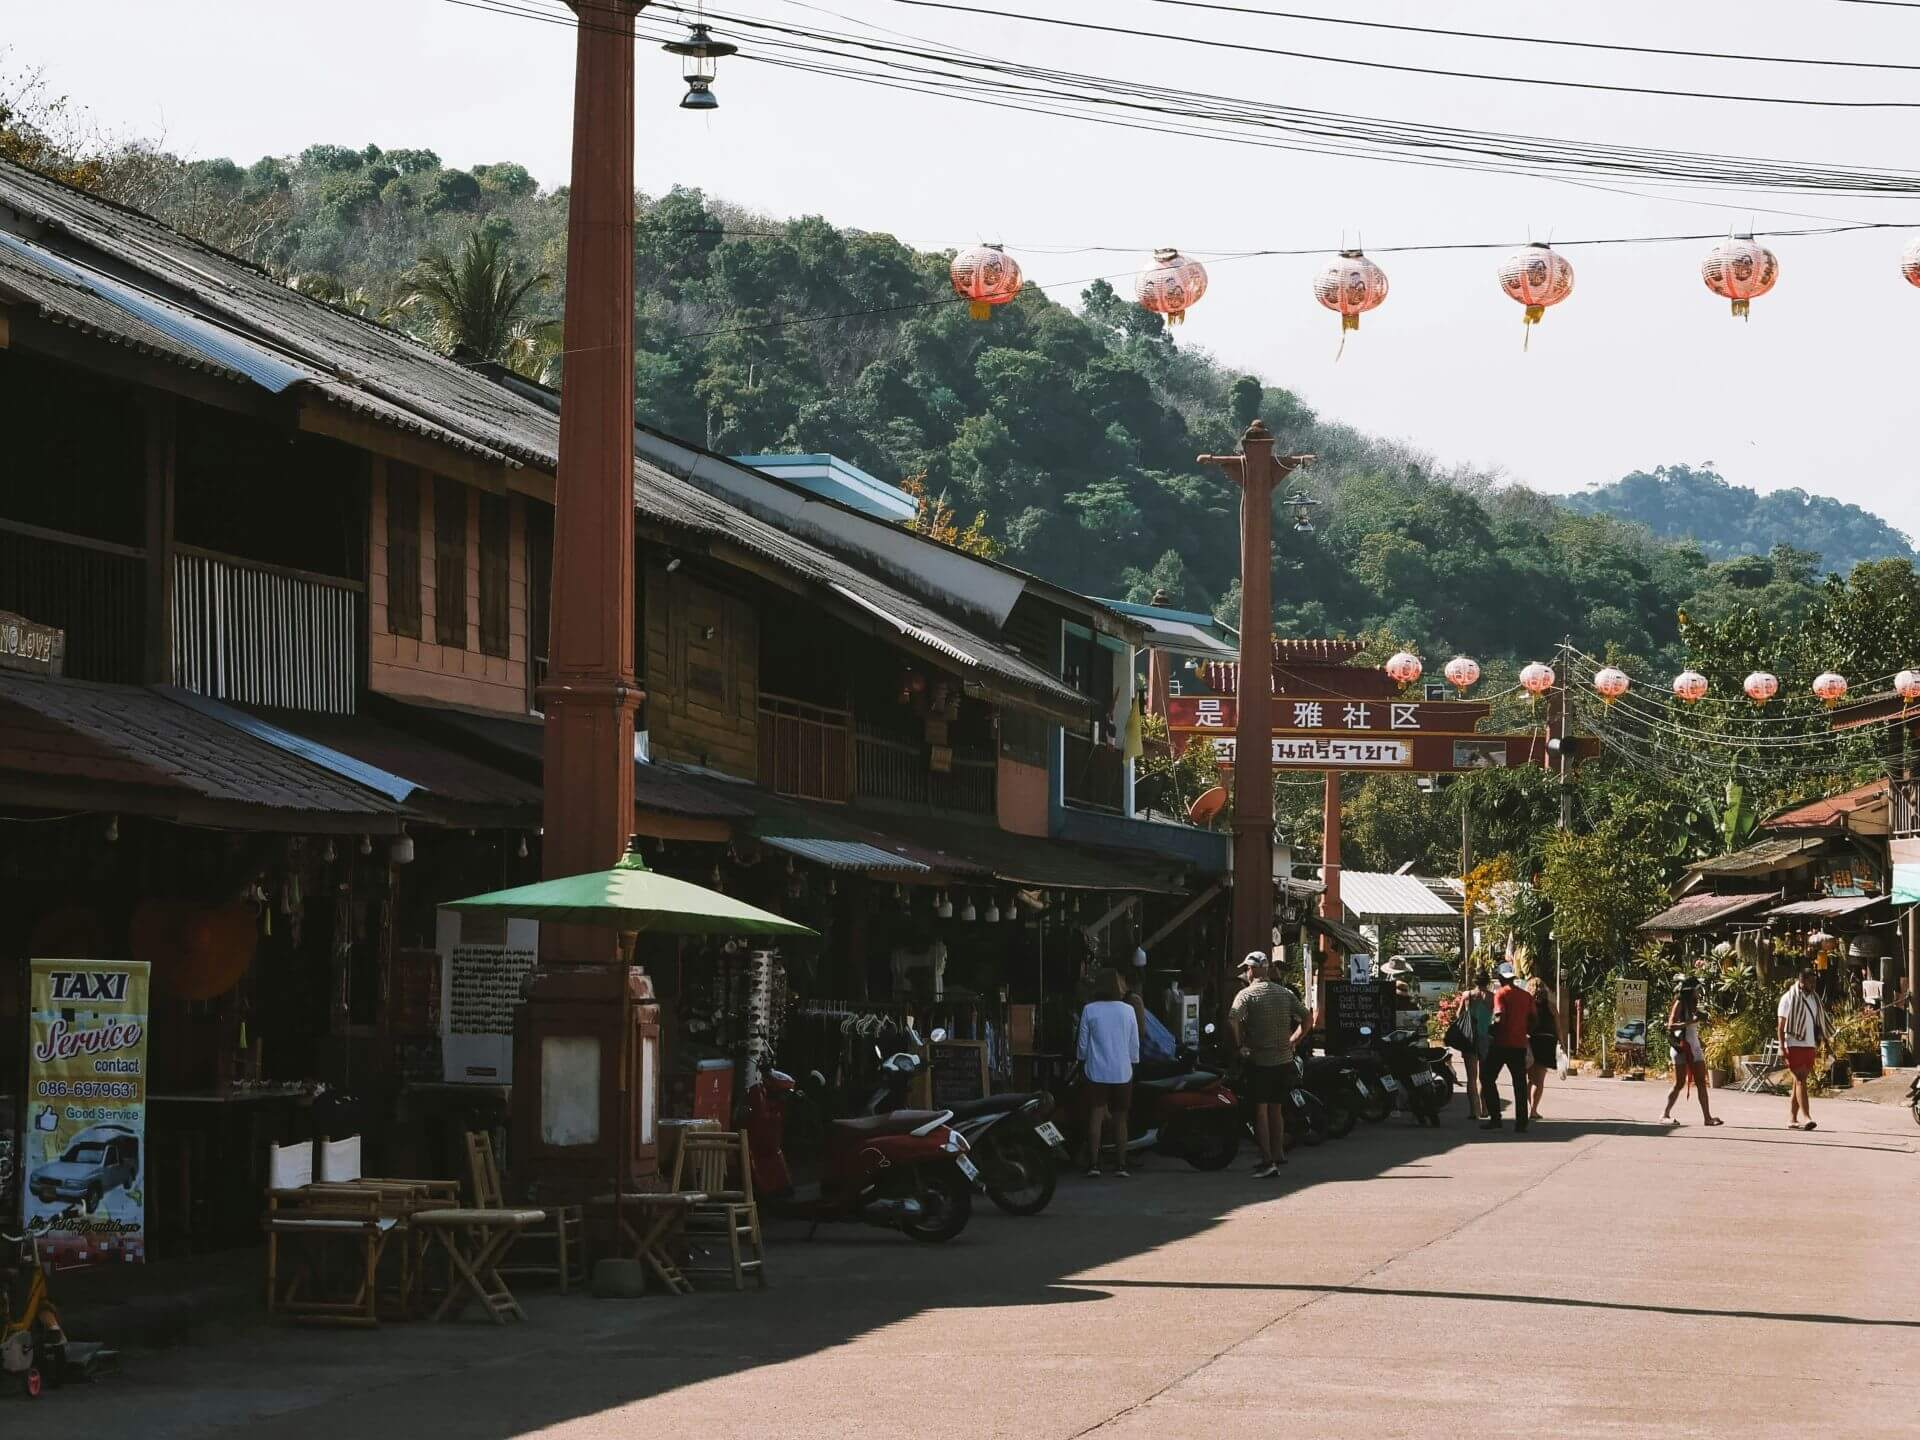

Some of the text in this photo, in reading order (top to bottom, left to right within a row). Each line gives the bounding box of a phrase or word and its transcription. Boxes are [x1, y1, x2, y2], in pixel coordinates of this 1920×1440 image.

[50, 971, 129, 1001] TAXI
[1623, 983, 1642, 991] TAXI
[35, 1018, 142, 1062] Service
[95, 1058, 139, 1073] contact
[38, 1081, 138, 1097] 086-6979631
[66, 1107, 139, 1120] Good Service
